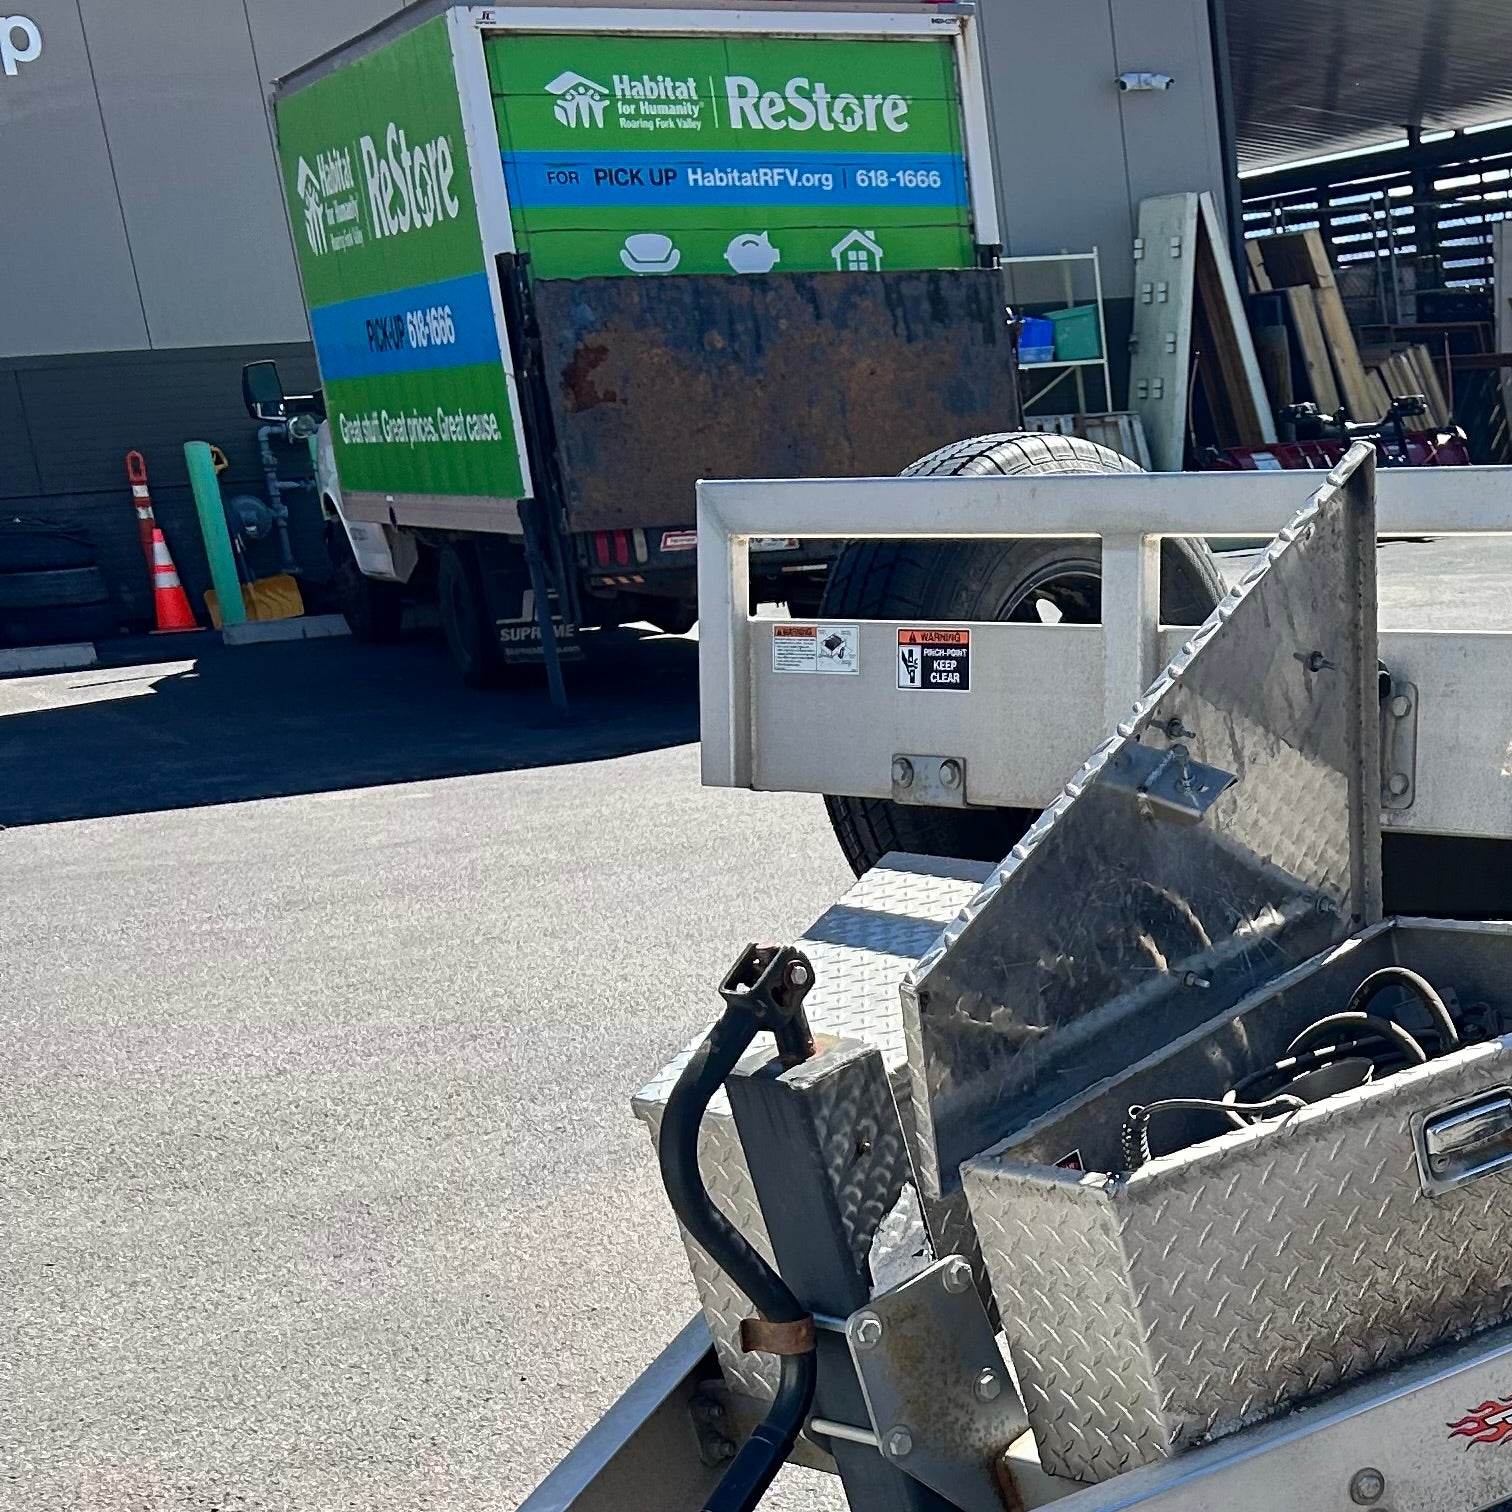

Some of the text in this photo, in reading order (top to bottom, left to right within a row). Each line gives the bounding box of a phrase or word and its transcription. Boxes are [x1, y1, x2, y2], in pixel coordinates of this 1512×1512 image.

[612, 75, 699, 100] Habitat
[618, 101, 700, 118] for Humanity
[725, 76, 910, 133] ReStore
[619, 118, 702, 131] Roaring Fork Valley
[360, 122, 459, 238] ReStore
[546, 167, 942, 190] FOR PICK UP HabitatRFV.org 618-1666
[406, 305, 455, 349] 618-1666
[339, 412, 364, 444] Great
[381, 409, 408, 443] Great
[406, 408, 439, 450] prices.
[437, 406, 467, 442] Great
[466, 412, 502, 442] cause.
[500, 623, 575, 642] SUPRME
[920, 632, 961, 642] WARNING
[933, 659, 957, 670] KEEP
[930, 672, 960, 683] CLEAR
